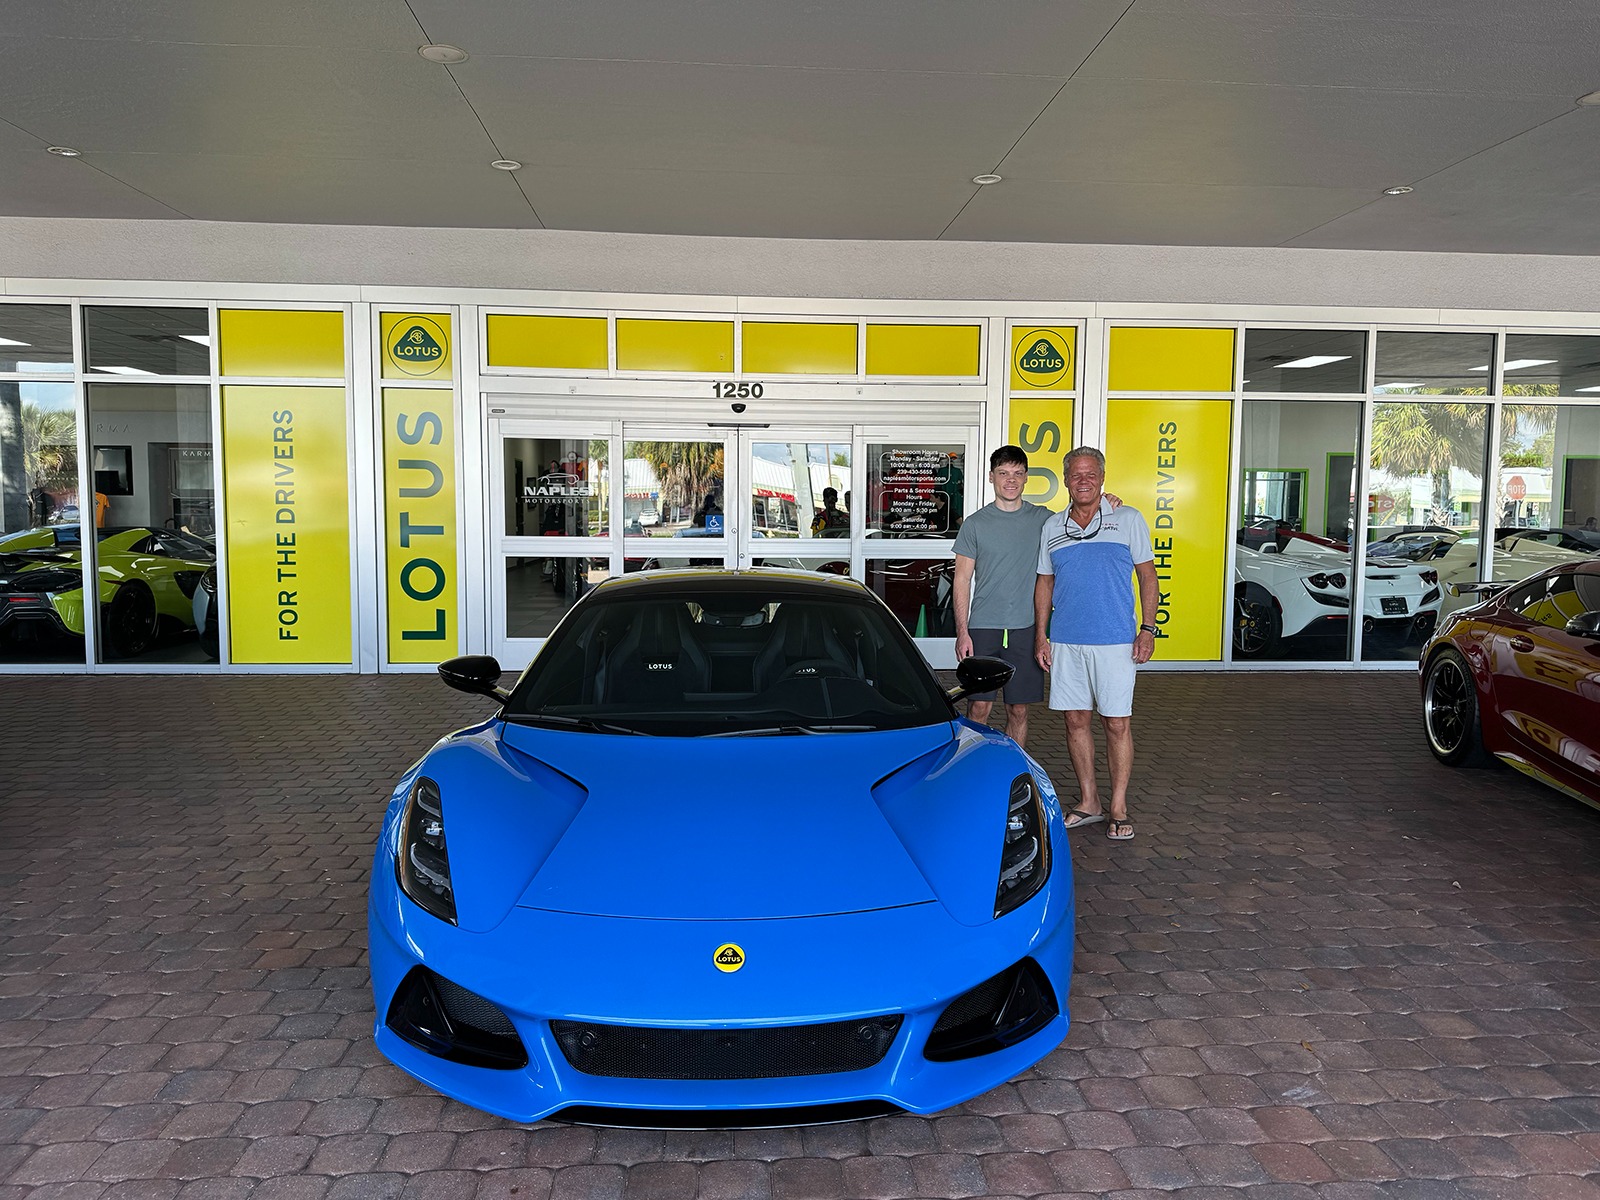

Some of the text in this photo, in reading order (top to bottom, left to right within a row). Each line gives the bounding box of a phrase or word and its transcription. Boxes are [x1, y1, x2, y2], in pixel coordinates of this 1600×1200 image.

[397, 346, 439, 357] LOTUS
[1023, 358, 1062, 368] LOTUS
[712, 382, 764, 399] 1250
[96, 424, 130, 433] RMA
[1155, 421, 1177, 529] DRIVERS
[524, 486, 590, 496] NAPLES
[272, 409, 299, 641] FOR THE DRIVERS
[396, 411, 446, 640] LOTUS
